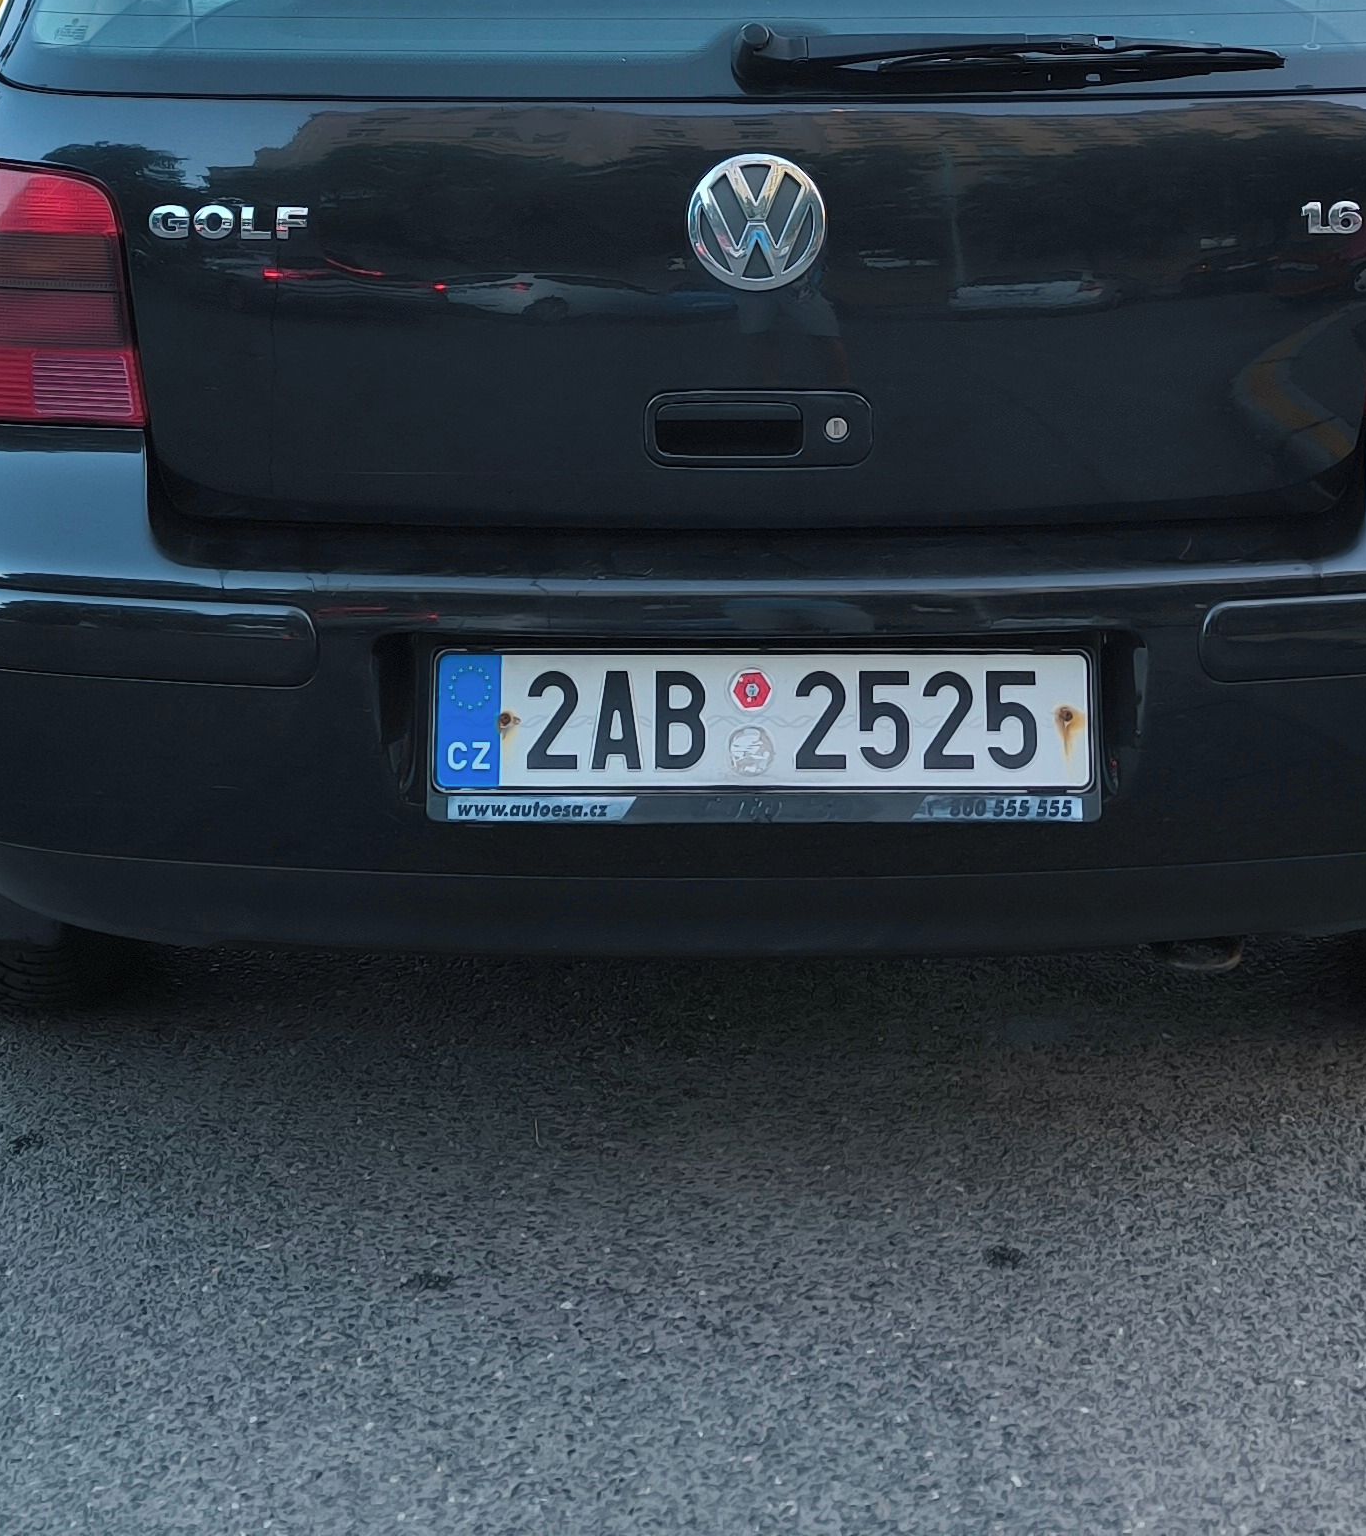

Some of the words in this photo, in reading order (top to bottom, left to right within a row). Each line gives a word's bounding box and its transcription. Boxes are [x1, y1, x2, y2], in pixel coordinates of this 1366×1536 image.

[148, 204, 309, 240] GOLF
[526, 670, 706, 770] 2AB
[794, 670, 1038, 770] 2525
[447, 741, 491, 770] CZ
[457, 802, 609, 818] www.autoesa.cz
[992, 799, 1031, 817] 555
[1035, 799, 1072, 817] 555
